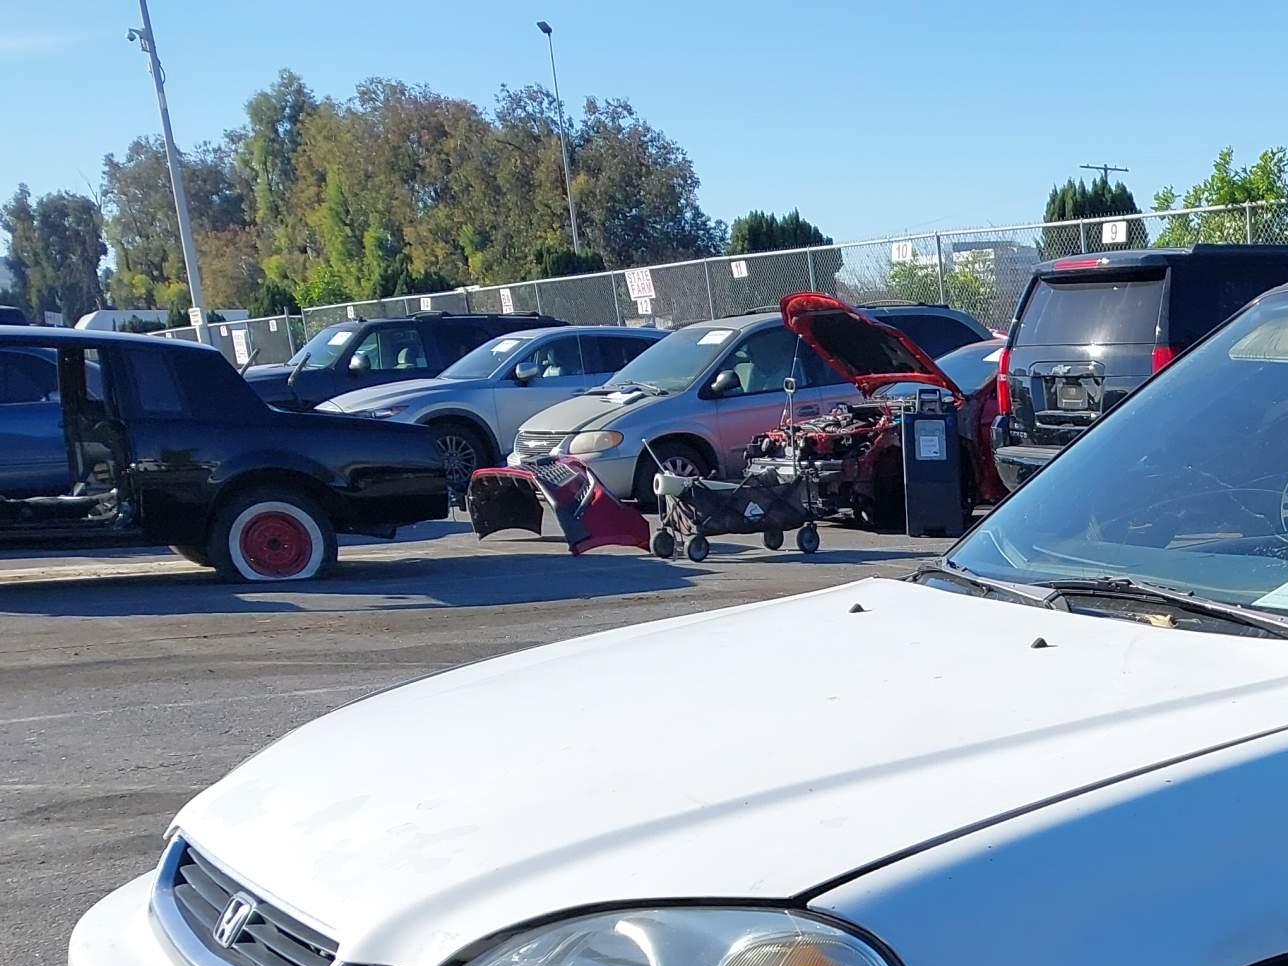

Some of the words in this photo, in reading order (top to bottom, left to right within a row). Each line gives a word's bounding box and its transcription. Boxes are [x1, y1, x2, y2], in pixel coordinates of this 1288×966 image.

[1111, 223, 1118, 241] 9
[896, 243, 908, 259] 10
[626, 270, 651, 283] STATE
[630, 281, 654, 296] FARM
[640, 299, 650, 312] 12
